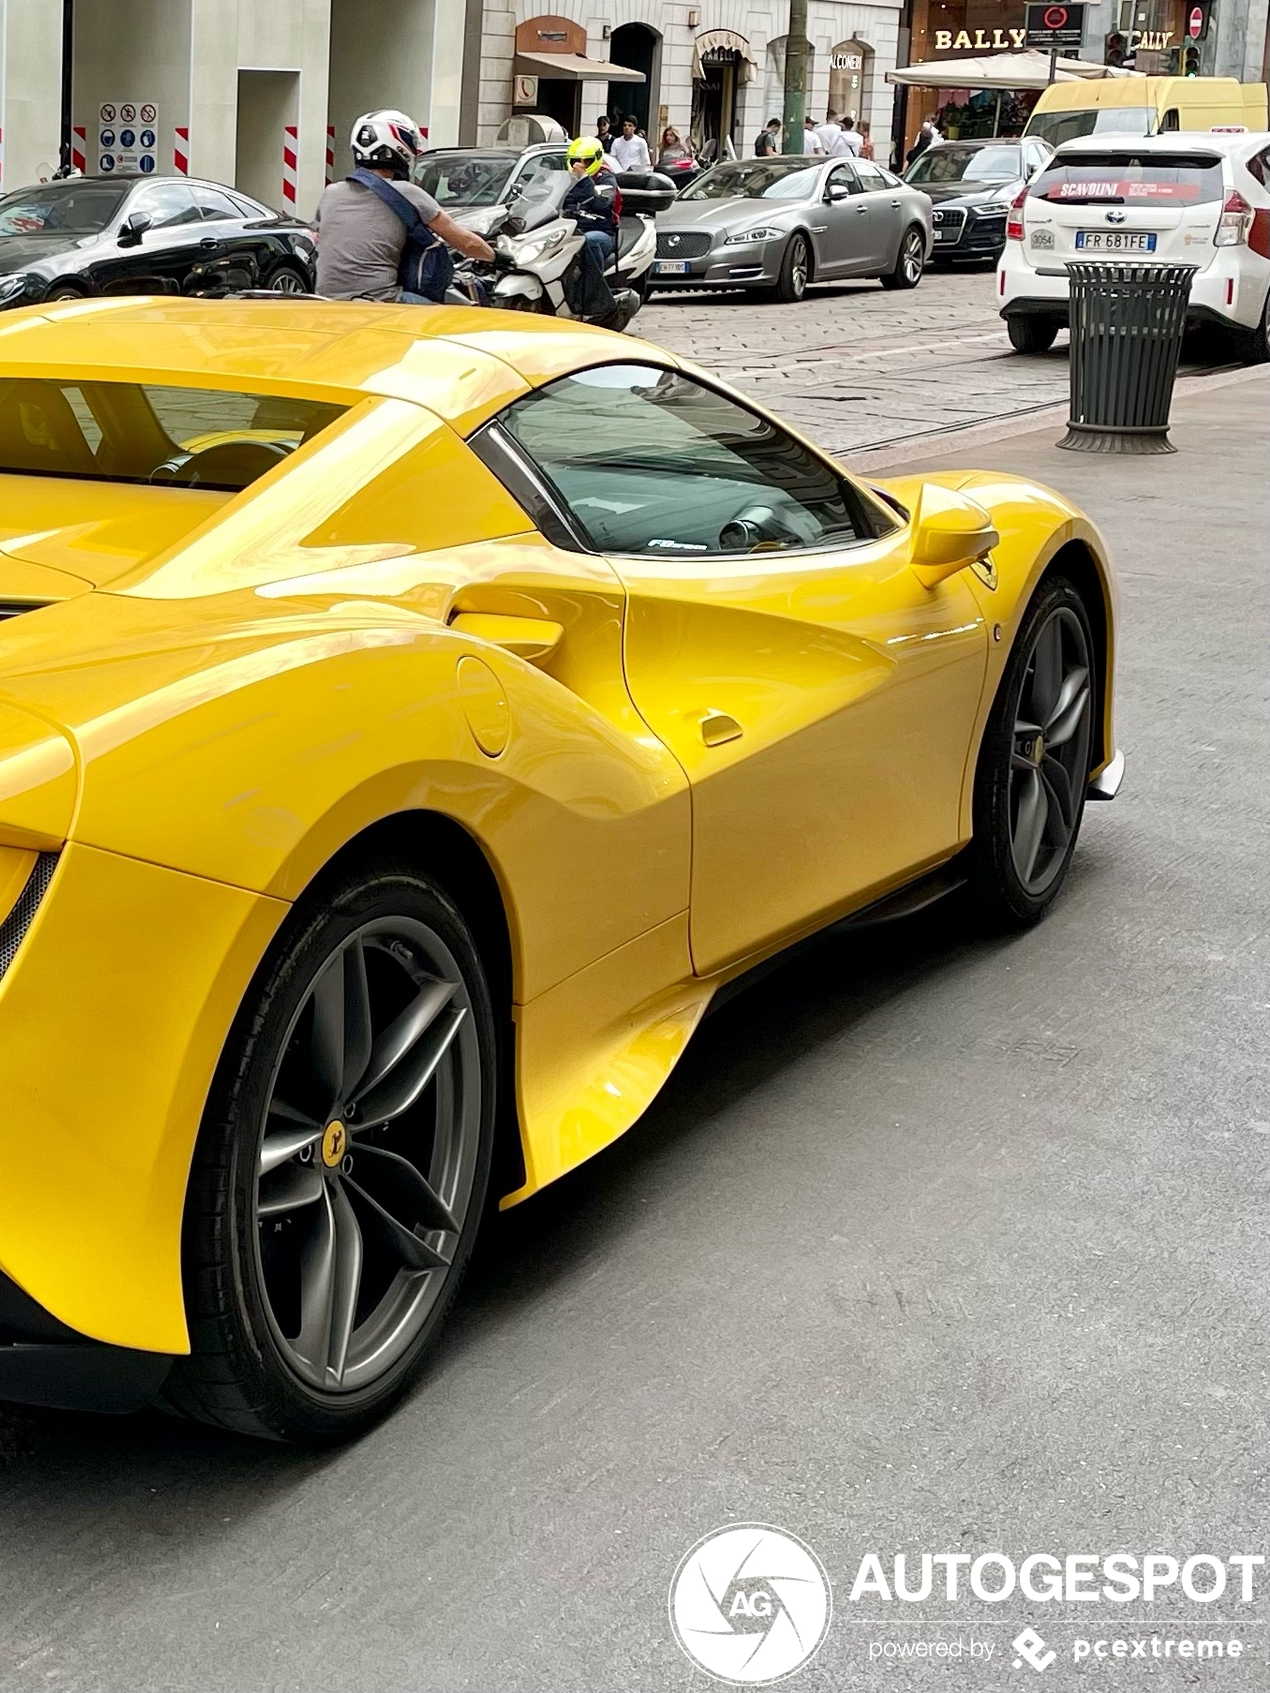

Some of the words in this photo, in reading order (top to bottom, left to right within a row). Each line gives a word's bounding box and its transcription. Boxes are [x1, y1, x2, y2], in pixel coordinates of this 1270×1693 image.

[935, 29, 1026, 50] BALLY
[1060, 183, 1118, 196] SCAVOLINI
[1085, 234, 1101, 247] FR
[1106, 234, 1147, 248] 681FE
